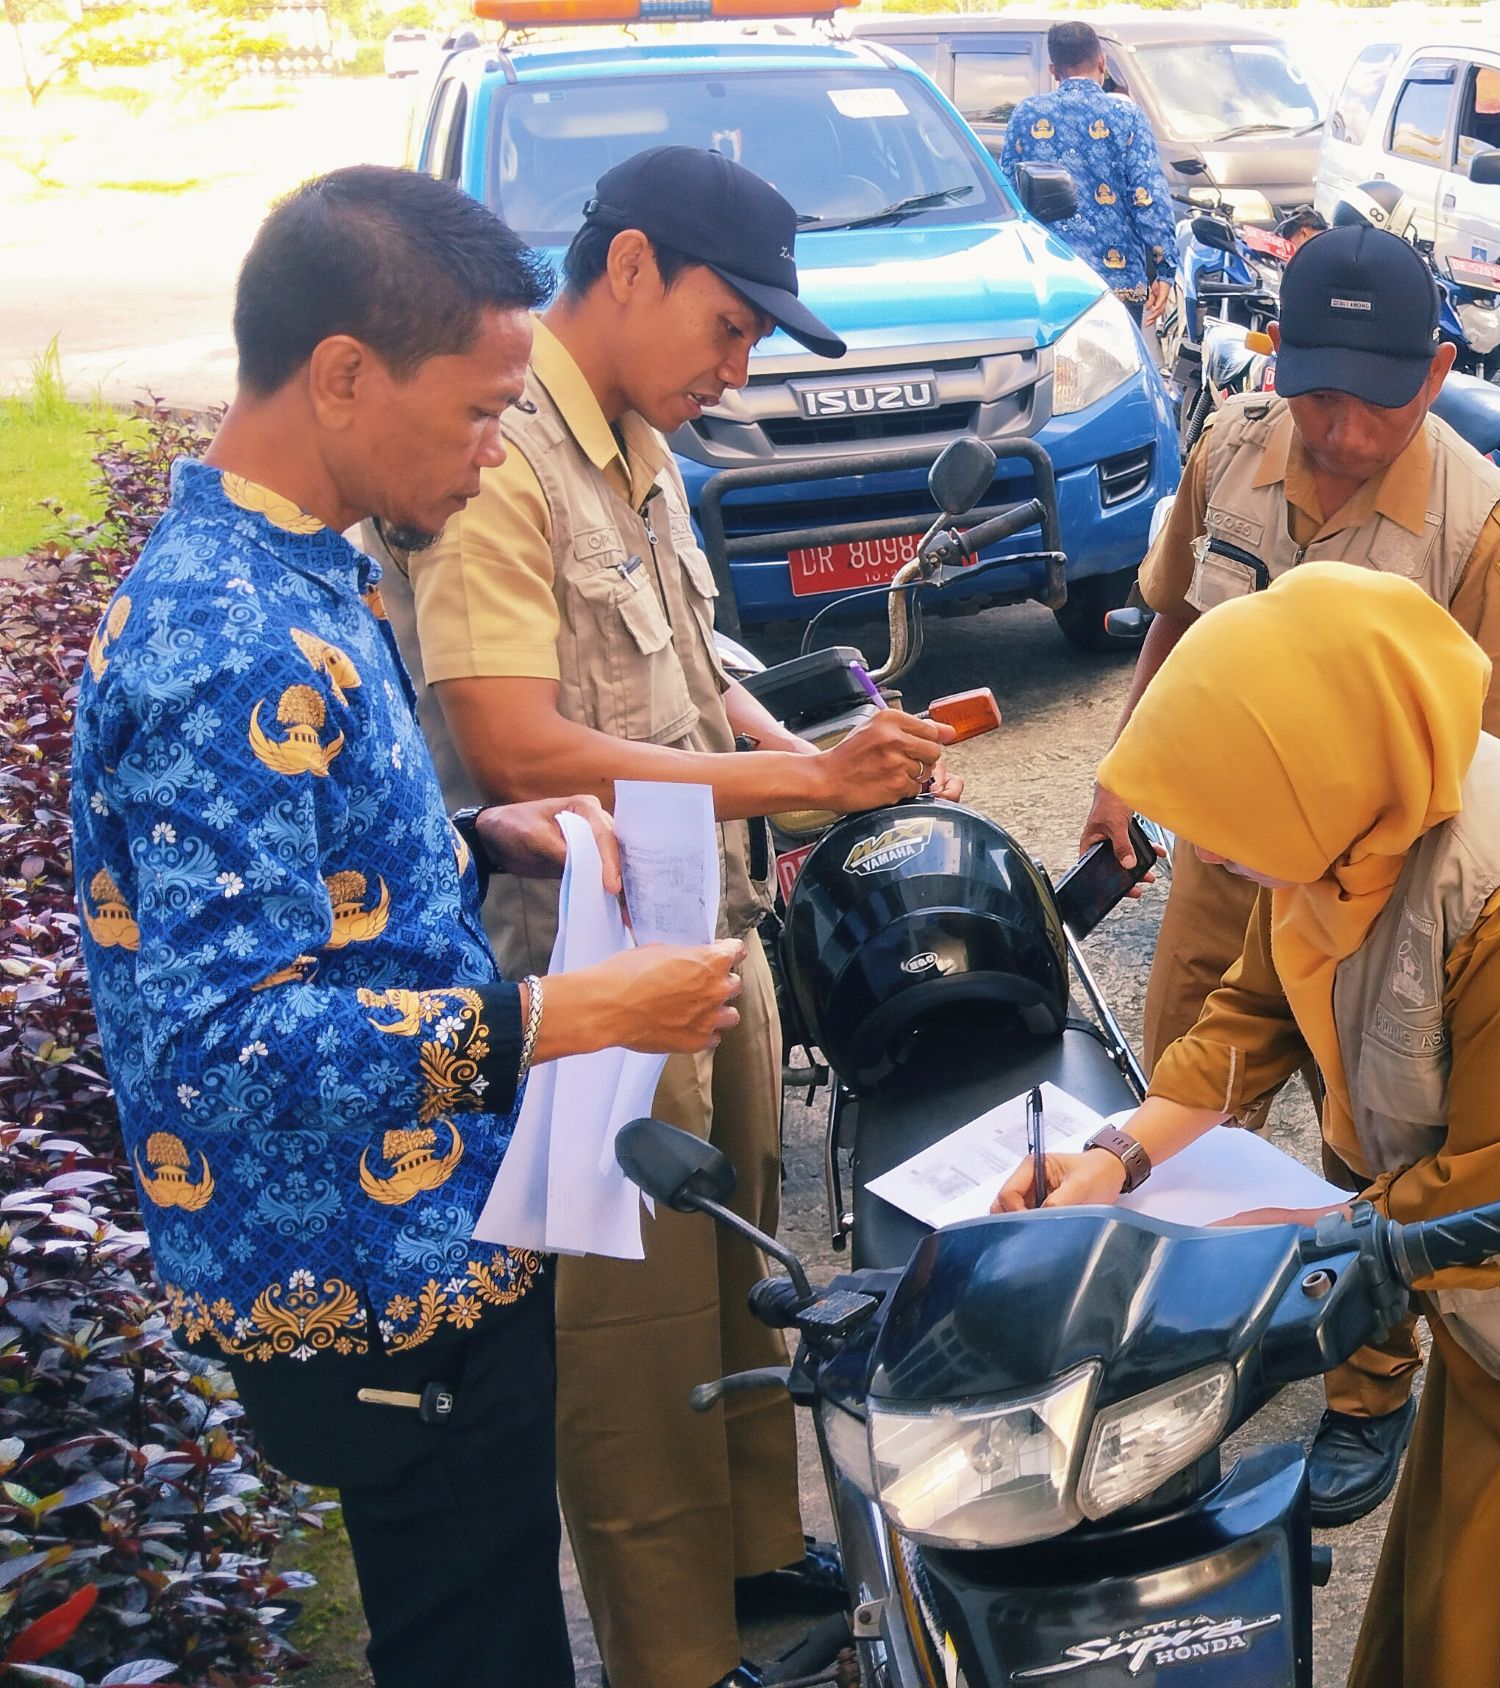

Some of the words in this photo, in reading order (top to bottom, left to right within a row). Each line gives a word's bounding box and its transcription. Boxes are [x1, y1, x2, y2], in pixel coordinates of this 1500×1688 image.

[804, 382, 931, 416] ISUZU
[800, 546, 835, 577] DR
[849, 535, 915, 569] 8098
[862, 844, 917, 872] YAMAHA
[1155, 1634, 1248, 1666] HONDA
